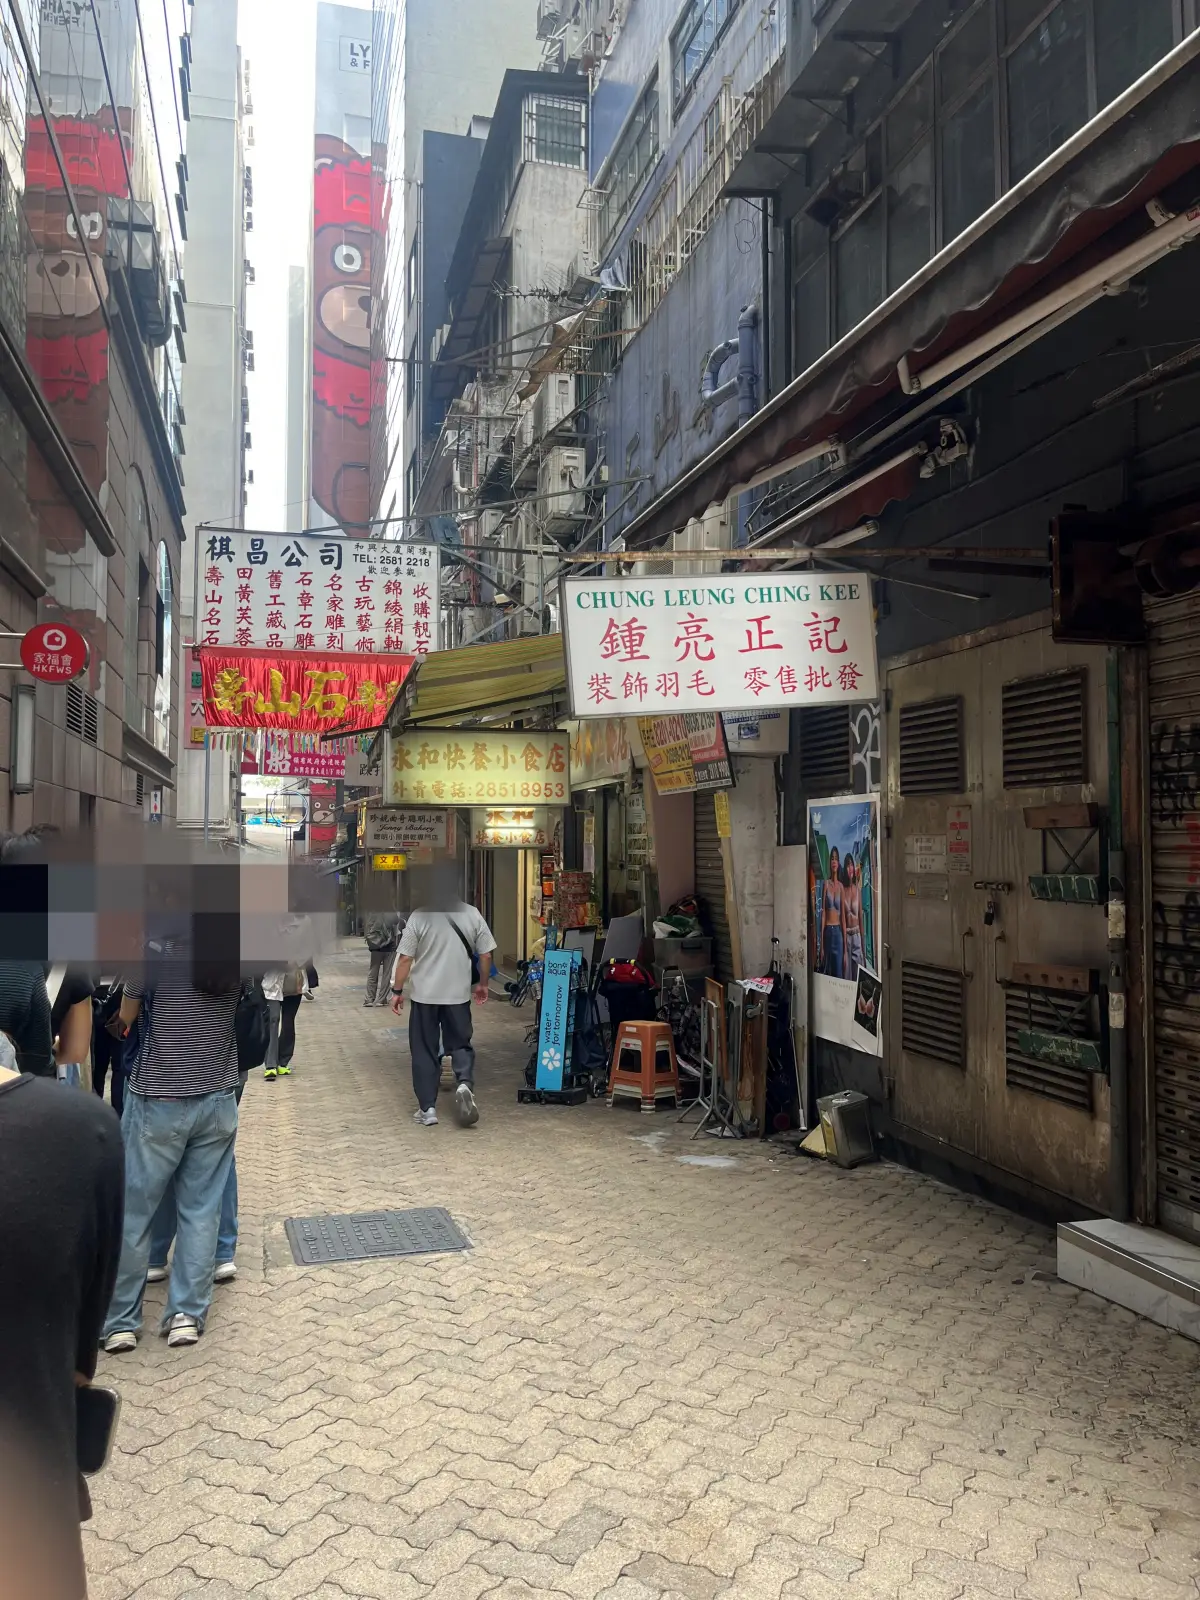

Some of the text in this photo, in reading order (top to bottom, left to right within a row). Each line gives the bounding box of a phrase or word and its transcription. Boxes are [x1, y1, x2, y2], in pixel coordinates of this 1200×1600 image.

[205, 535, 343, 570] 棋昌公司
[353, 553, 430, 567] TEL: 2581 2218
[233, 567, 255, 647] 田黃芙蓉
[264, 569, 286, 648] 舊工藏品
[293, 571, 316, 650] 石章石雕
[323, 573, 345, 651] 名家雕刻
[353, 575, 376, 653] 古玩藝術
[382, 578, 404, 654] 錦綾絹軸
[576, 583, 861, 609] CHUNG LEUNG CHING KEE
[411, 581, 432, 655] 收購靚石
[599, 611, 849, 663] 鍾亮正記
[32, 664, 72, 674] HKFWS
[33, 652, 73, 666] 家福會
[587, 661, 863, 704] 裝飾羽毛 零售批發
[391, 742, 565, 772] 永和快餐小食店
[376, 823, 435, 833] Jenny Bakery
[475, 828, 545, 845] 快餐小食店
[379, 855, 400, 864] 文具
[553, 985, 563, 1030] tomorrow
